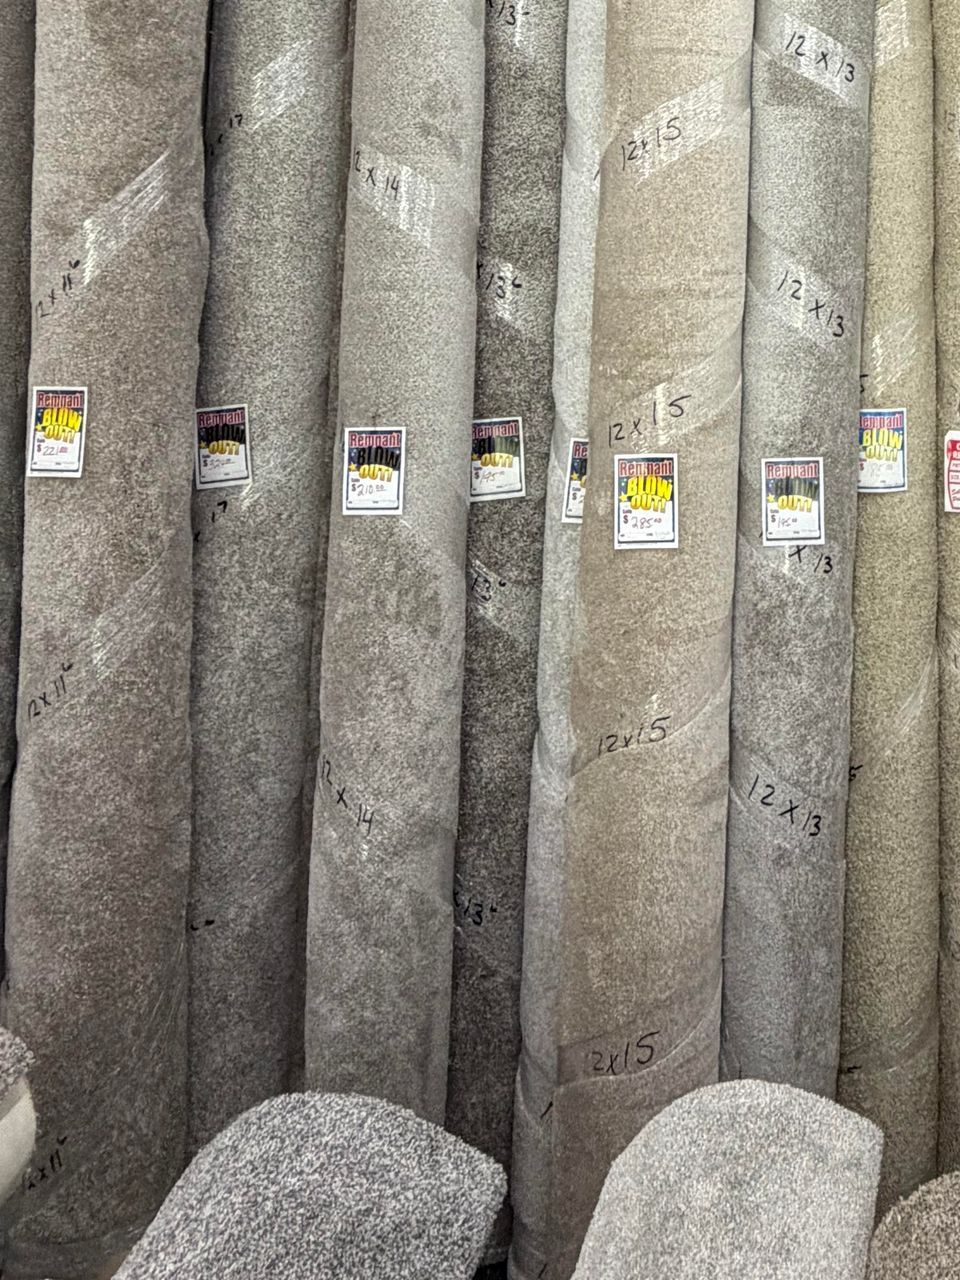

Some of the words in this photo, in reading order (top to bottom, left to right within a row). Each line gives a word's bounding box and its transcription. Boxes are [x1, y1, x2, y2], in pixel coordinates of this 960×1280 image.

[36, 391, 84, 408] Remnant
[42, 407, 82, 432] BLOW
[198, 409, 245, 428] Remnant
[349, 432, 401, 448] Remnant
[862, 428, 903, 450] BLOW
[357, 446, 401, 471] BLOW
[618, 460, 673, 477] Remnant
[766, 463, 818, 479] Remnant
[627, 475, 672, 502] BLOW
[630, 493, 667, 514] OUT!
